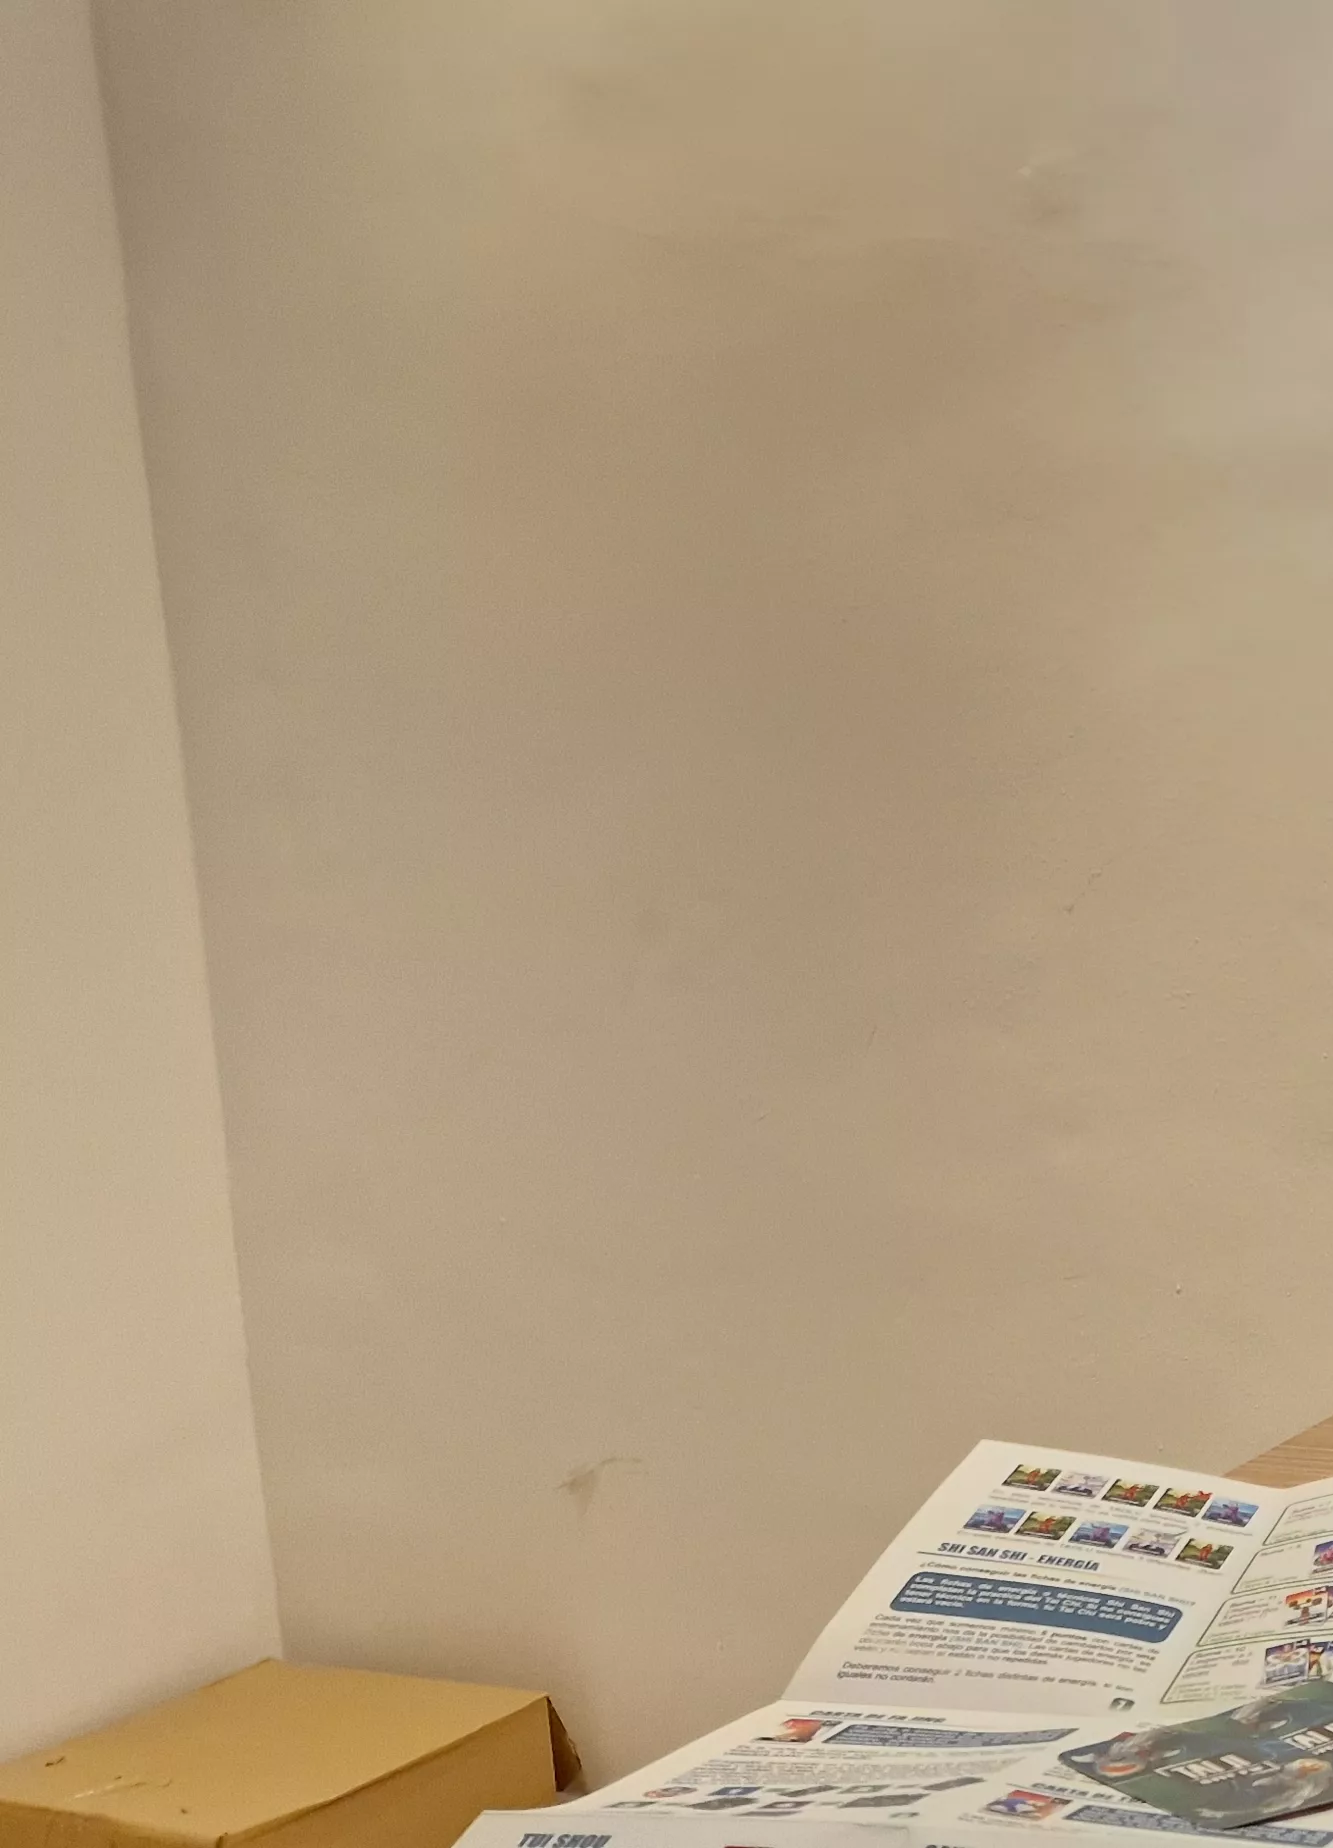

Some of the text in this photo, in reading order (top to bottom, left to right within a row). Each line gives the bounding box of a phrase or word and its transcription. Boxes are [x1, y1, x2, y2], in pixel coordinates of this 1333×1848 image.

[937, 1542, 967, 1554] SHI
[967, 1545, 998, 1558] SAN
[999, 1550, 1028, 1561] SHI
[1037, 1554, 1100, 1571] ENERGÍA
[517, 1833, 555, 1848] TUI
